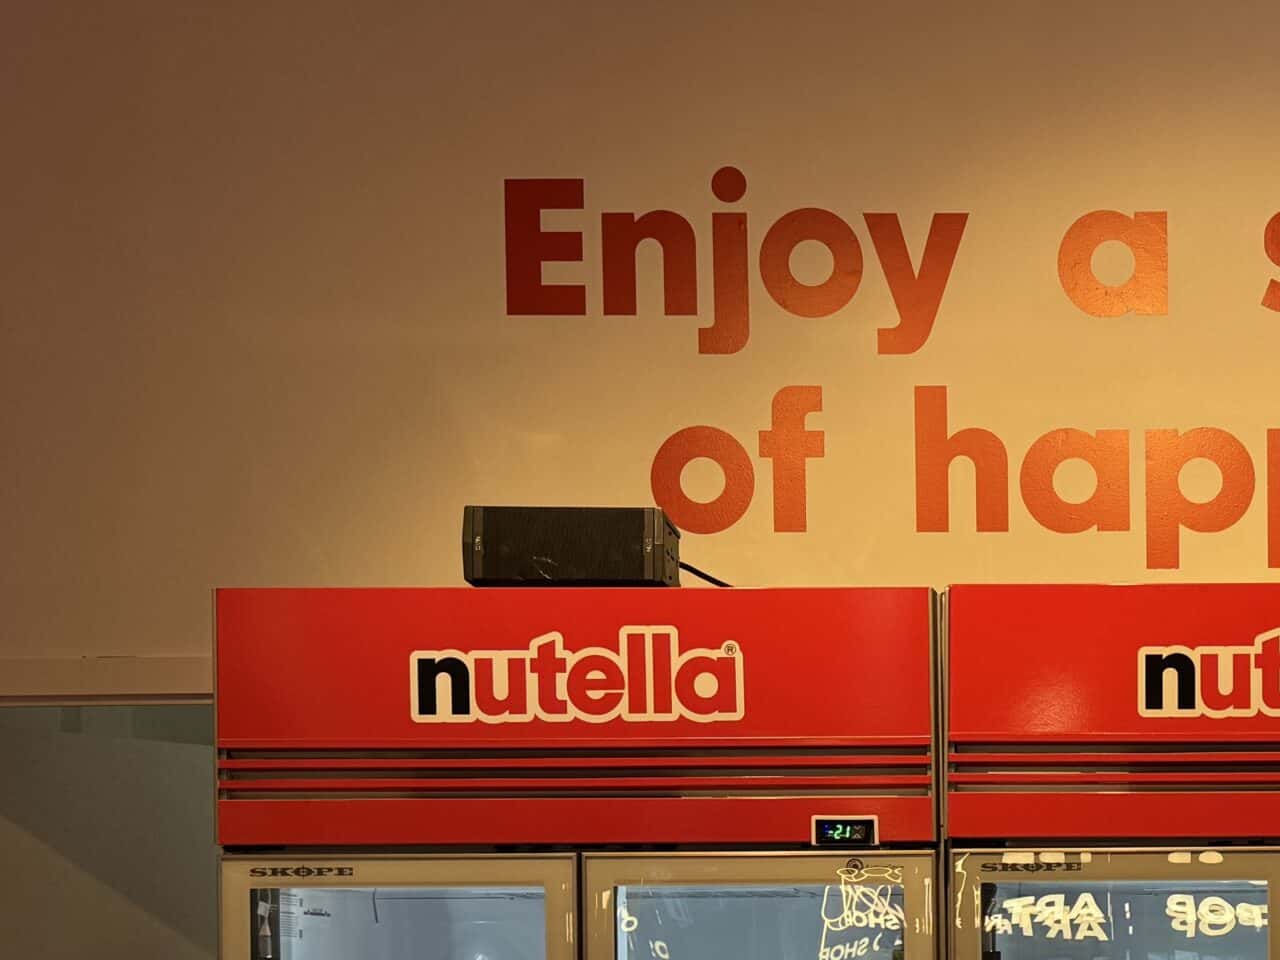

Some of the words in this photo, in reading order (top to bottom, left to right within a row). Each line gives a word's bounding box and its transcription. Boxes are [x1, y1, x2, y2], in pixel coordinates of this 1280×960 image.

[504, 166, 969, 355] Enjoy
[1057, 209, 1169, 318] a
[650, 385, 825, 534] of
[416, 632, 738, 717] nutella
[249, 865, 354, 879] SKOPE
[980, 861, 1082, 873] SKOPE
